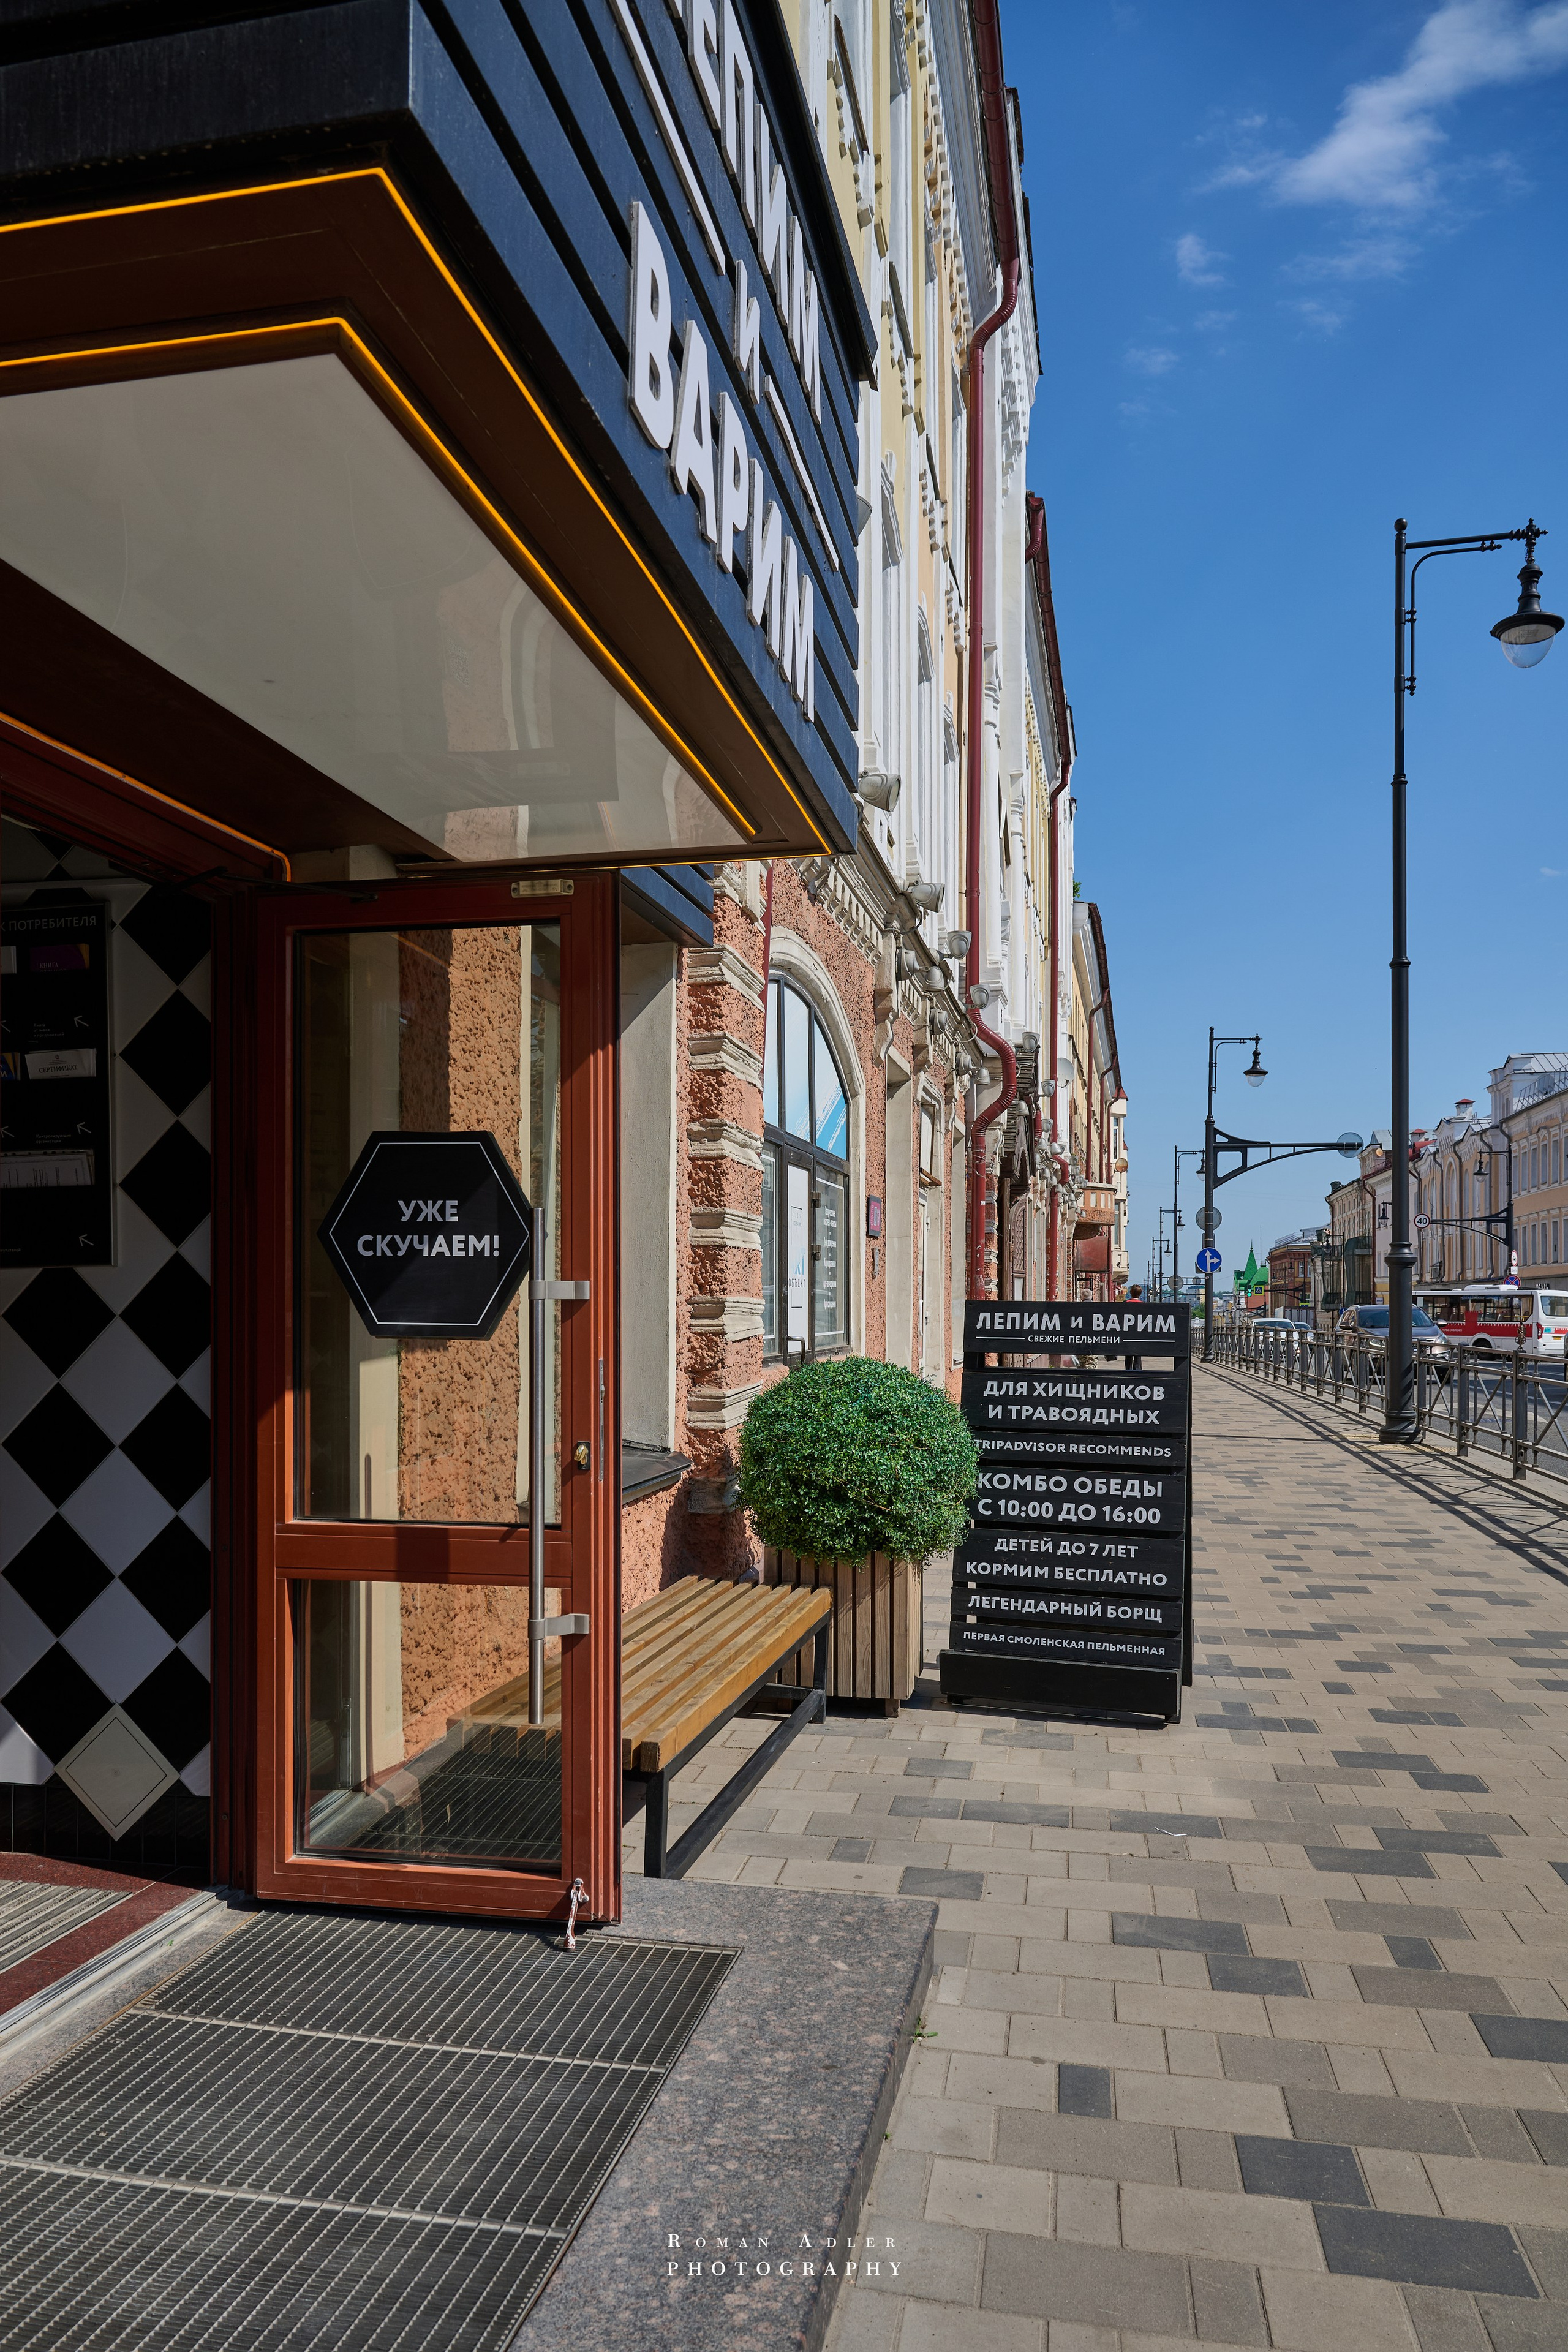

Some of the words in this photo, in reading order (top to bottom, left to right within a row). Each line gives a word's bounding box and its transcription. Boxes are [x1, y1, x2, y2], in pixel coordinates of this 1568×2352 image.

[669, 0, 821, 424] ЕПИМ
[629, 201, 815, 723] ВАРИМ
[9, 916, 97, 931] ПОТРЕБИТЕЛЯ
[39, 1065, 77, 1073] СЕРТИФИКАТ
[398, 1200, 458, 1221] УЖЕ
[357, 1235, 499, 1256] СКУЧАЕМ!
[976, 1312, 1061, 1330] ЛЕПИМ
[1092, 1314, 1176, 1332] ВАРИМ
[983, 1381, 1027, 1397] ДЛЯ
[1033, 1382, 1164, 1400] ХИЩНИКОВ
[988, 1404, 1003, 1419] И
[1008, 1405, 1160, 1425] ТРАВОЯДНЫХ
[974, 1439, 1066, 1453] TRIPADVISOR
[1069, 1444, 1172, 1457] RECOMMENDS
[978, 1473, 1067, 1493] КОМБО
[1074, 1477, 1163, 1498] ОБЕДЫ
[978, 1499, 992, 1515] С
[998, 1499, 1054, 1518] 10:00
[1058, 1503, 1096, 1523] ДО
[1102, 1505, 1161, 1524] 16:00
[994, 1537, 1053, 1553] ДЕТЕЙ
[1057, 1542, 1086, 1556] ДО
[1090, 1544, 1099, 1556] 7
[1102, 1544, 1139, 1558] ЛЕТ
[966, 1562, 1049, 1578] КОРМИМ
[1054, 1567, 1167, 1586] БЕСПЛАТНО
[968, 1595, 1102, 1617] ЛЕГЕНДАРНЫЙ
[1107, 1606, 1163, 1623] БОРЩ
[963, 1631, 1005, 1642] ПЕРВАЯ
[1007, 1635, 1084, 1649] СМОЛЕНСКАЯ
[1087, 1642, 1165, 1656] ПЕЛЬМЕННАЯ
